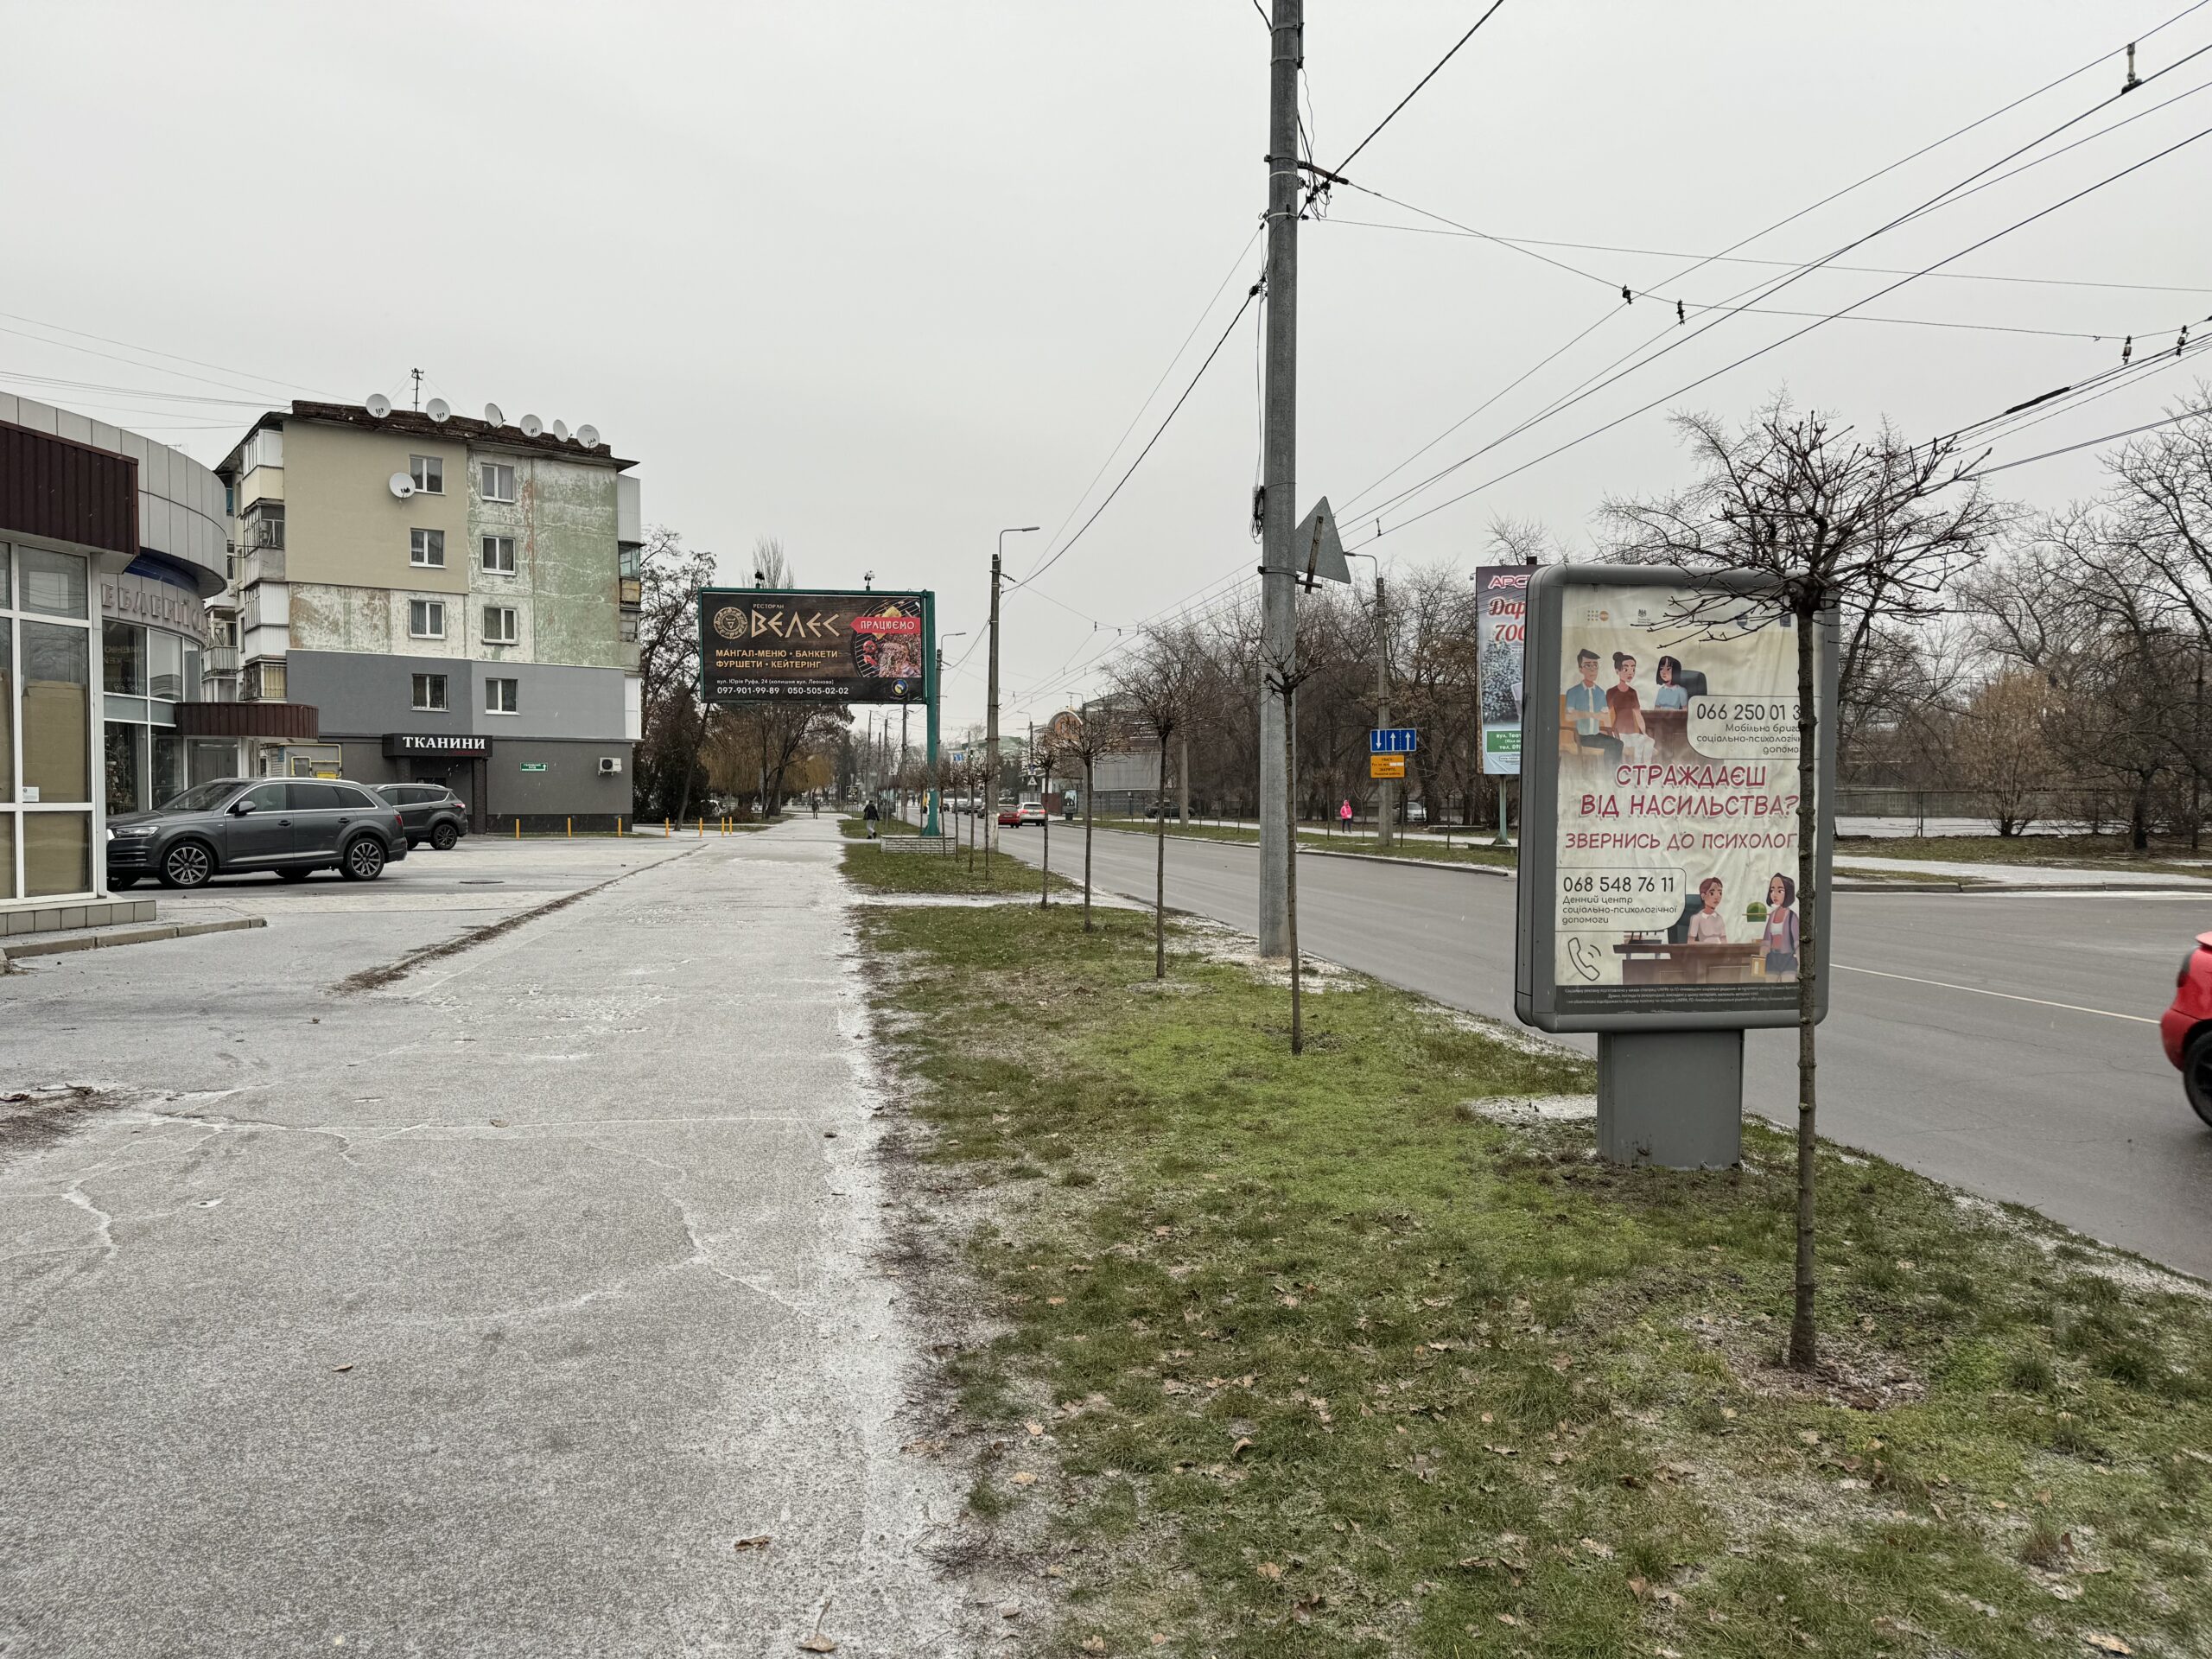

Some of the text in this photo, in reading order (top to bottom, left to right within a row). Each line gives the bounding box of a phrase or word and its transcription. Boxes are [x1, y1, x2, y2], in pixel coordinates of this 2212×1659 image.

[1488, 575, 1529, 589] АРС
[751, 609, 840, 639] ВЕЛЕС
[861, 620, 915, 631] ПРАЦЮЄМО
[715, 649, 838, 658] МАНГАЛ-МЕНЮ БАНКЕТИ
[715, 659, 821, 670] ФУРШЕТИ КЕЙТЕРІНГ
[1696, 703, 1802, 721] 066 250 01 3
[1725, 723, 1770, 733] Мобільна
[403, 736, 486, 750] ТКАНИНИ
[1763, 747, 1800, 755] допомо
[1615, 765, 1766, 788] СТРАЖДАЄШ
[1580, 794, 1799, 818] ВІД НАСИЛЬСТВА?
[1565, 832, 1800, 852] ЗВЕРНИСЬ ДО ПСИХОЛОГ
[1563, 877, 1675, 893] 068 548 76 11
[1562, 895, 1633, 906] Денний центр
[1561, 905, 1678, 916] соціально-психологічної
[1561, 916, 1610, 925] допомоги
